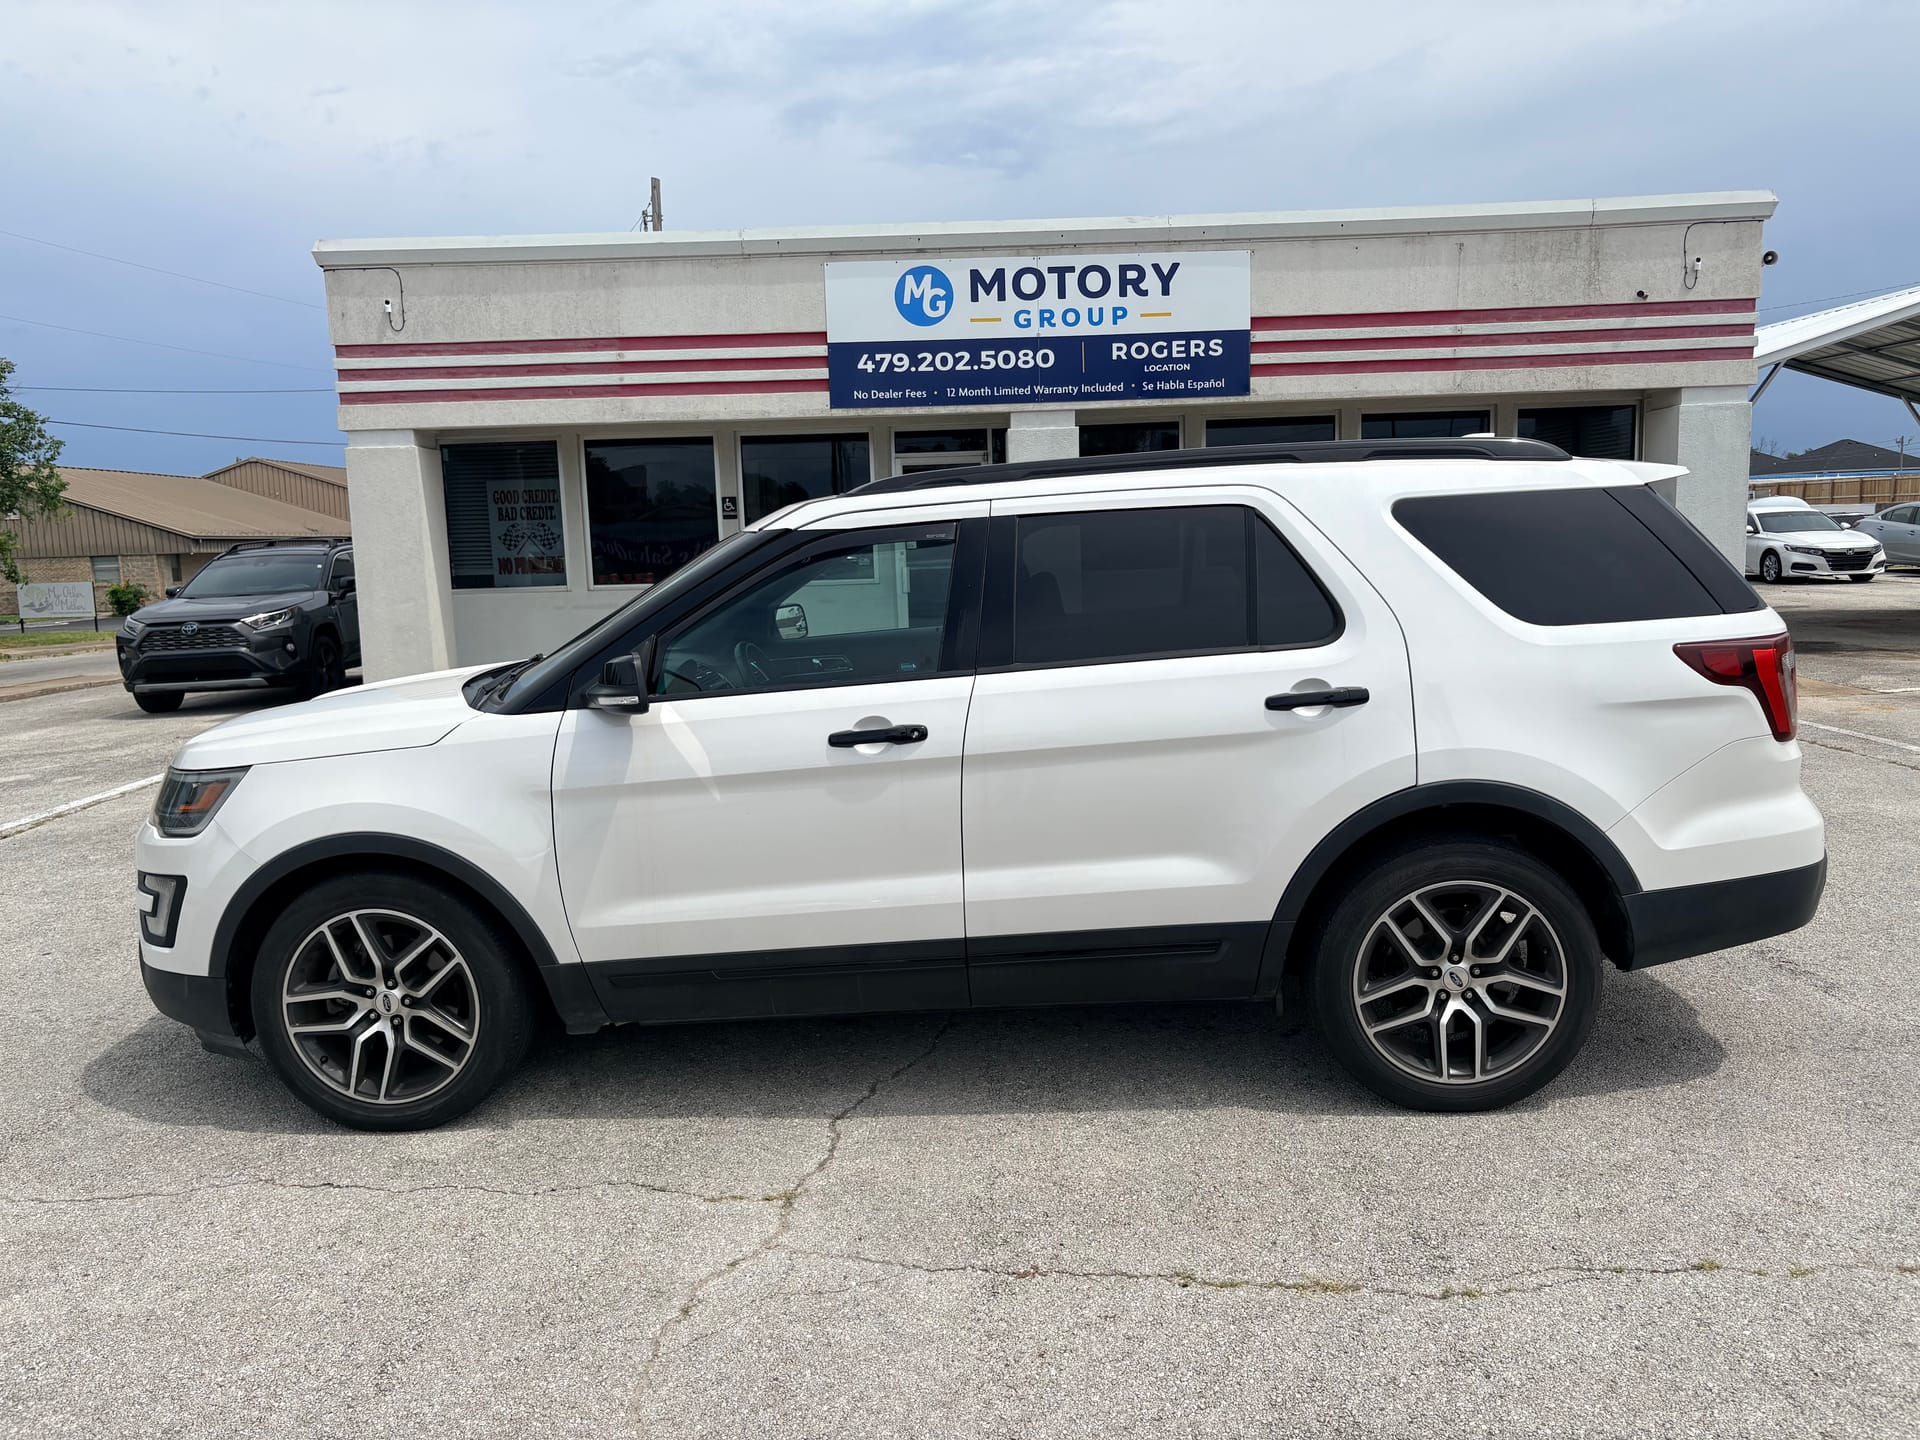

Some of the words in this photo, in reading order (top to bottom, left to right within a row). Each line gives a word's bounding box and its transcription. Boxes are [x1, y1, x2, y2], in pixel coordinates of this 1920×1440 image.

[969, 262, 1180, 302] MOTORY
[1014, 306, 1128, 329] GROUP
[1112, 339, 1223, 360] ROGERS
[857, 348, 1055, 373] 479.202.5080
[1144, 363, 1191, 373] LOCATION
[853, 390, 869, 399] No
[871, 389, 902, 399] Dealer
[905, 388, 927, 398] Fees
[946, 387, 956, 397] 12
[958, 387, 991, 397] Month
[994, 385, 1031, 396] Limited
[1034, 384, 1079, 396] Warranty
[1081, 382, 1124, 393] Included
[1142, 381, 1154, 391] Se
[1156, 379, 1185, 390] Habla
[1187, 378, 1225, 391] Español
[493, 490, 519, 504] GOOD
[497, 506, 518, 521] BAD
